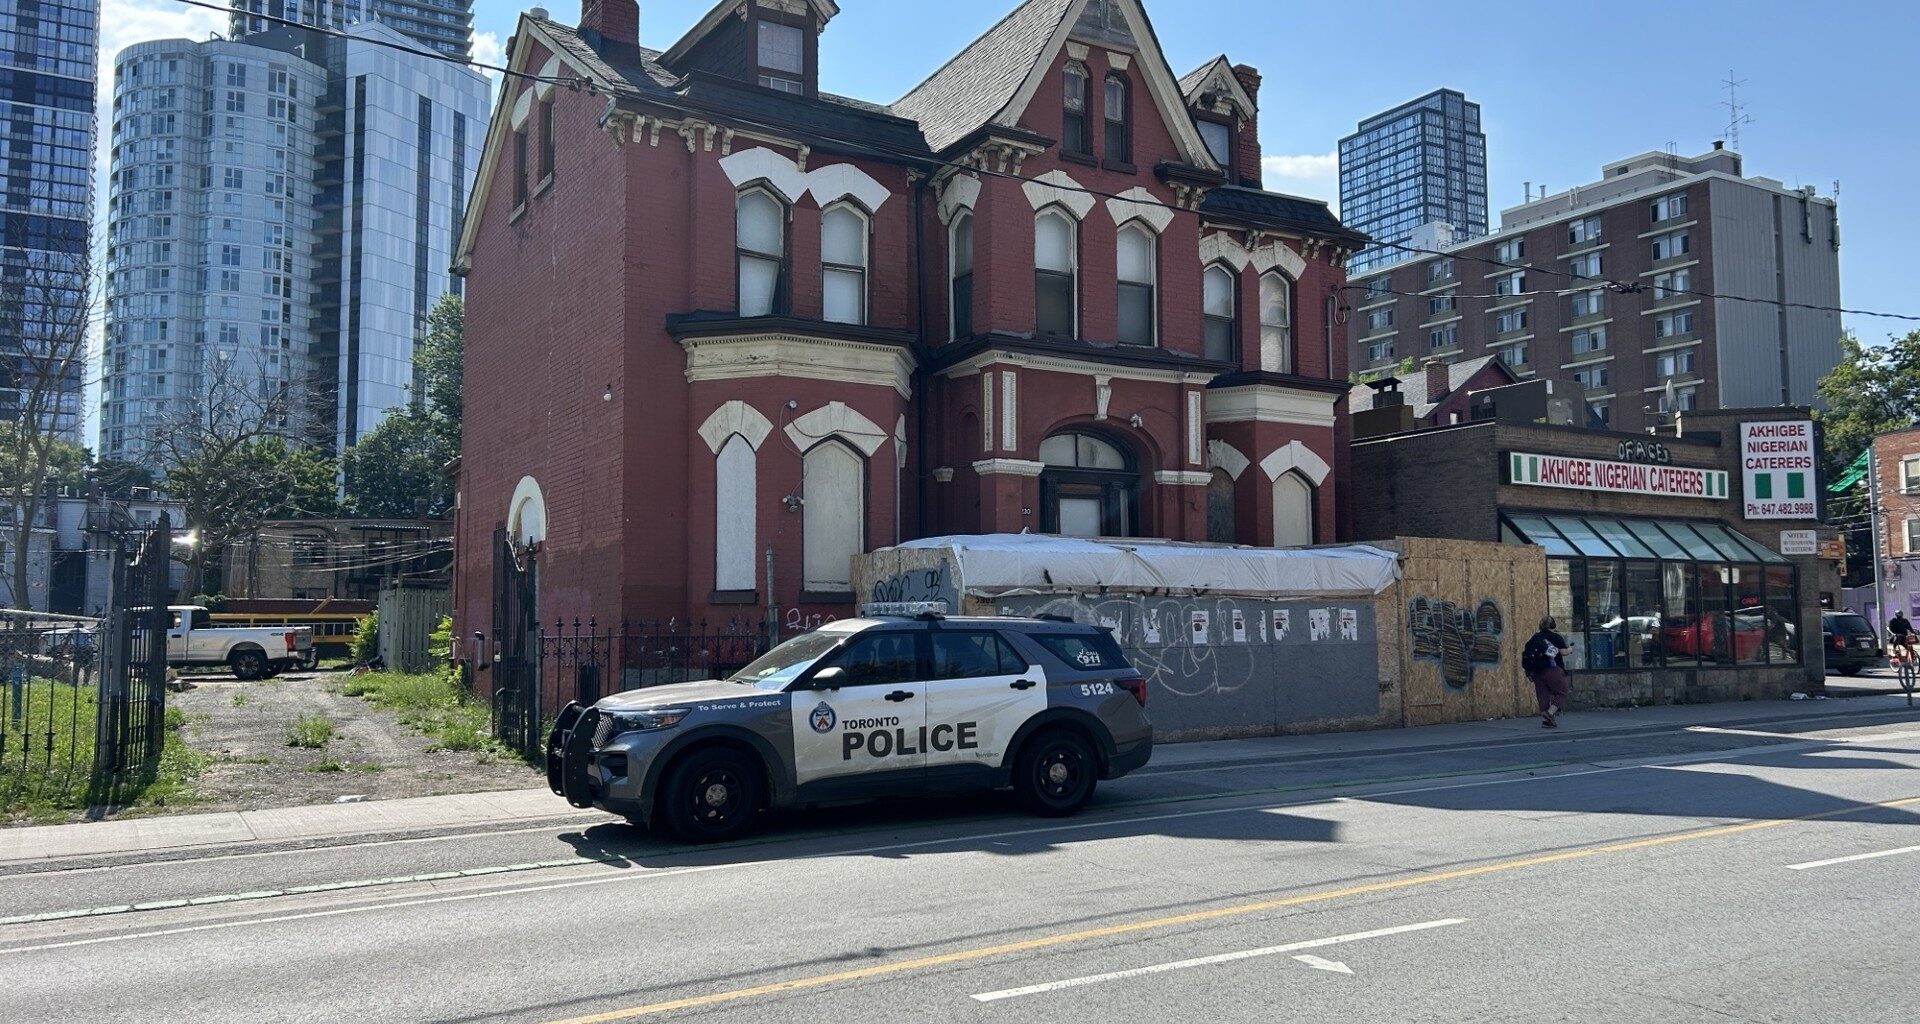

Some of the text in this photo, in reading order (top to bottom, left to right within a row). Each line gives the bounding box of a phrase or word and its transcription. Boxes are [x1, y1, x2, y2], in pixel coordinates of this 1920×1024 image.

[1748, 425, 1805, 438] AKHIGBE
[1747, 440, 1808, 453] NIGERIAN
[1745, 456, 1812, 470] CATERERS
[1541, 457, 1704, 495] AKHIGBE NIGERIAN CATERERS
[1746, 503, 1814, 515] Ph: 647.482.9988
[1082, 655, 1101, 664] 911
[1080, 682, 1114, 696] 5124
[842, 716, 899, 730] TORONTO
[842, 721, 979, 760] POLICE
